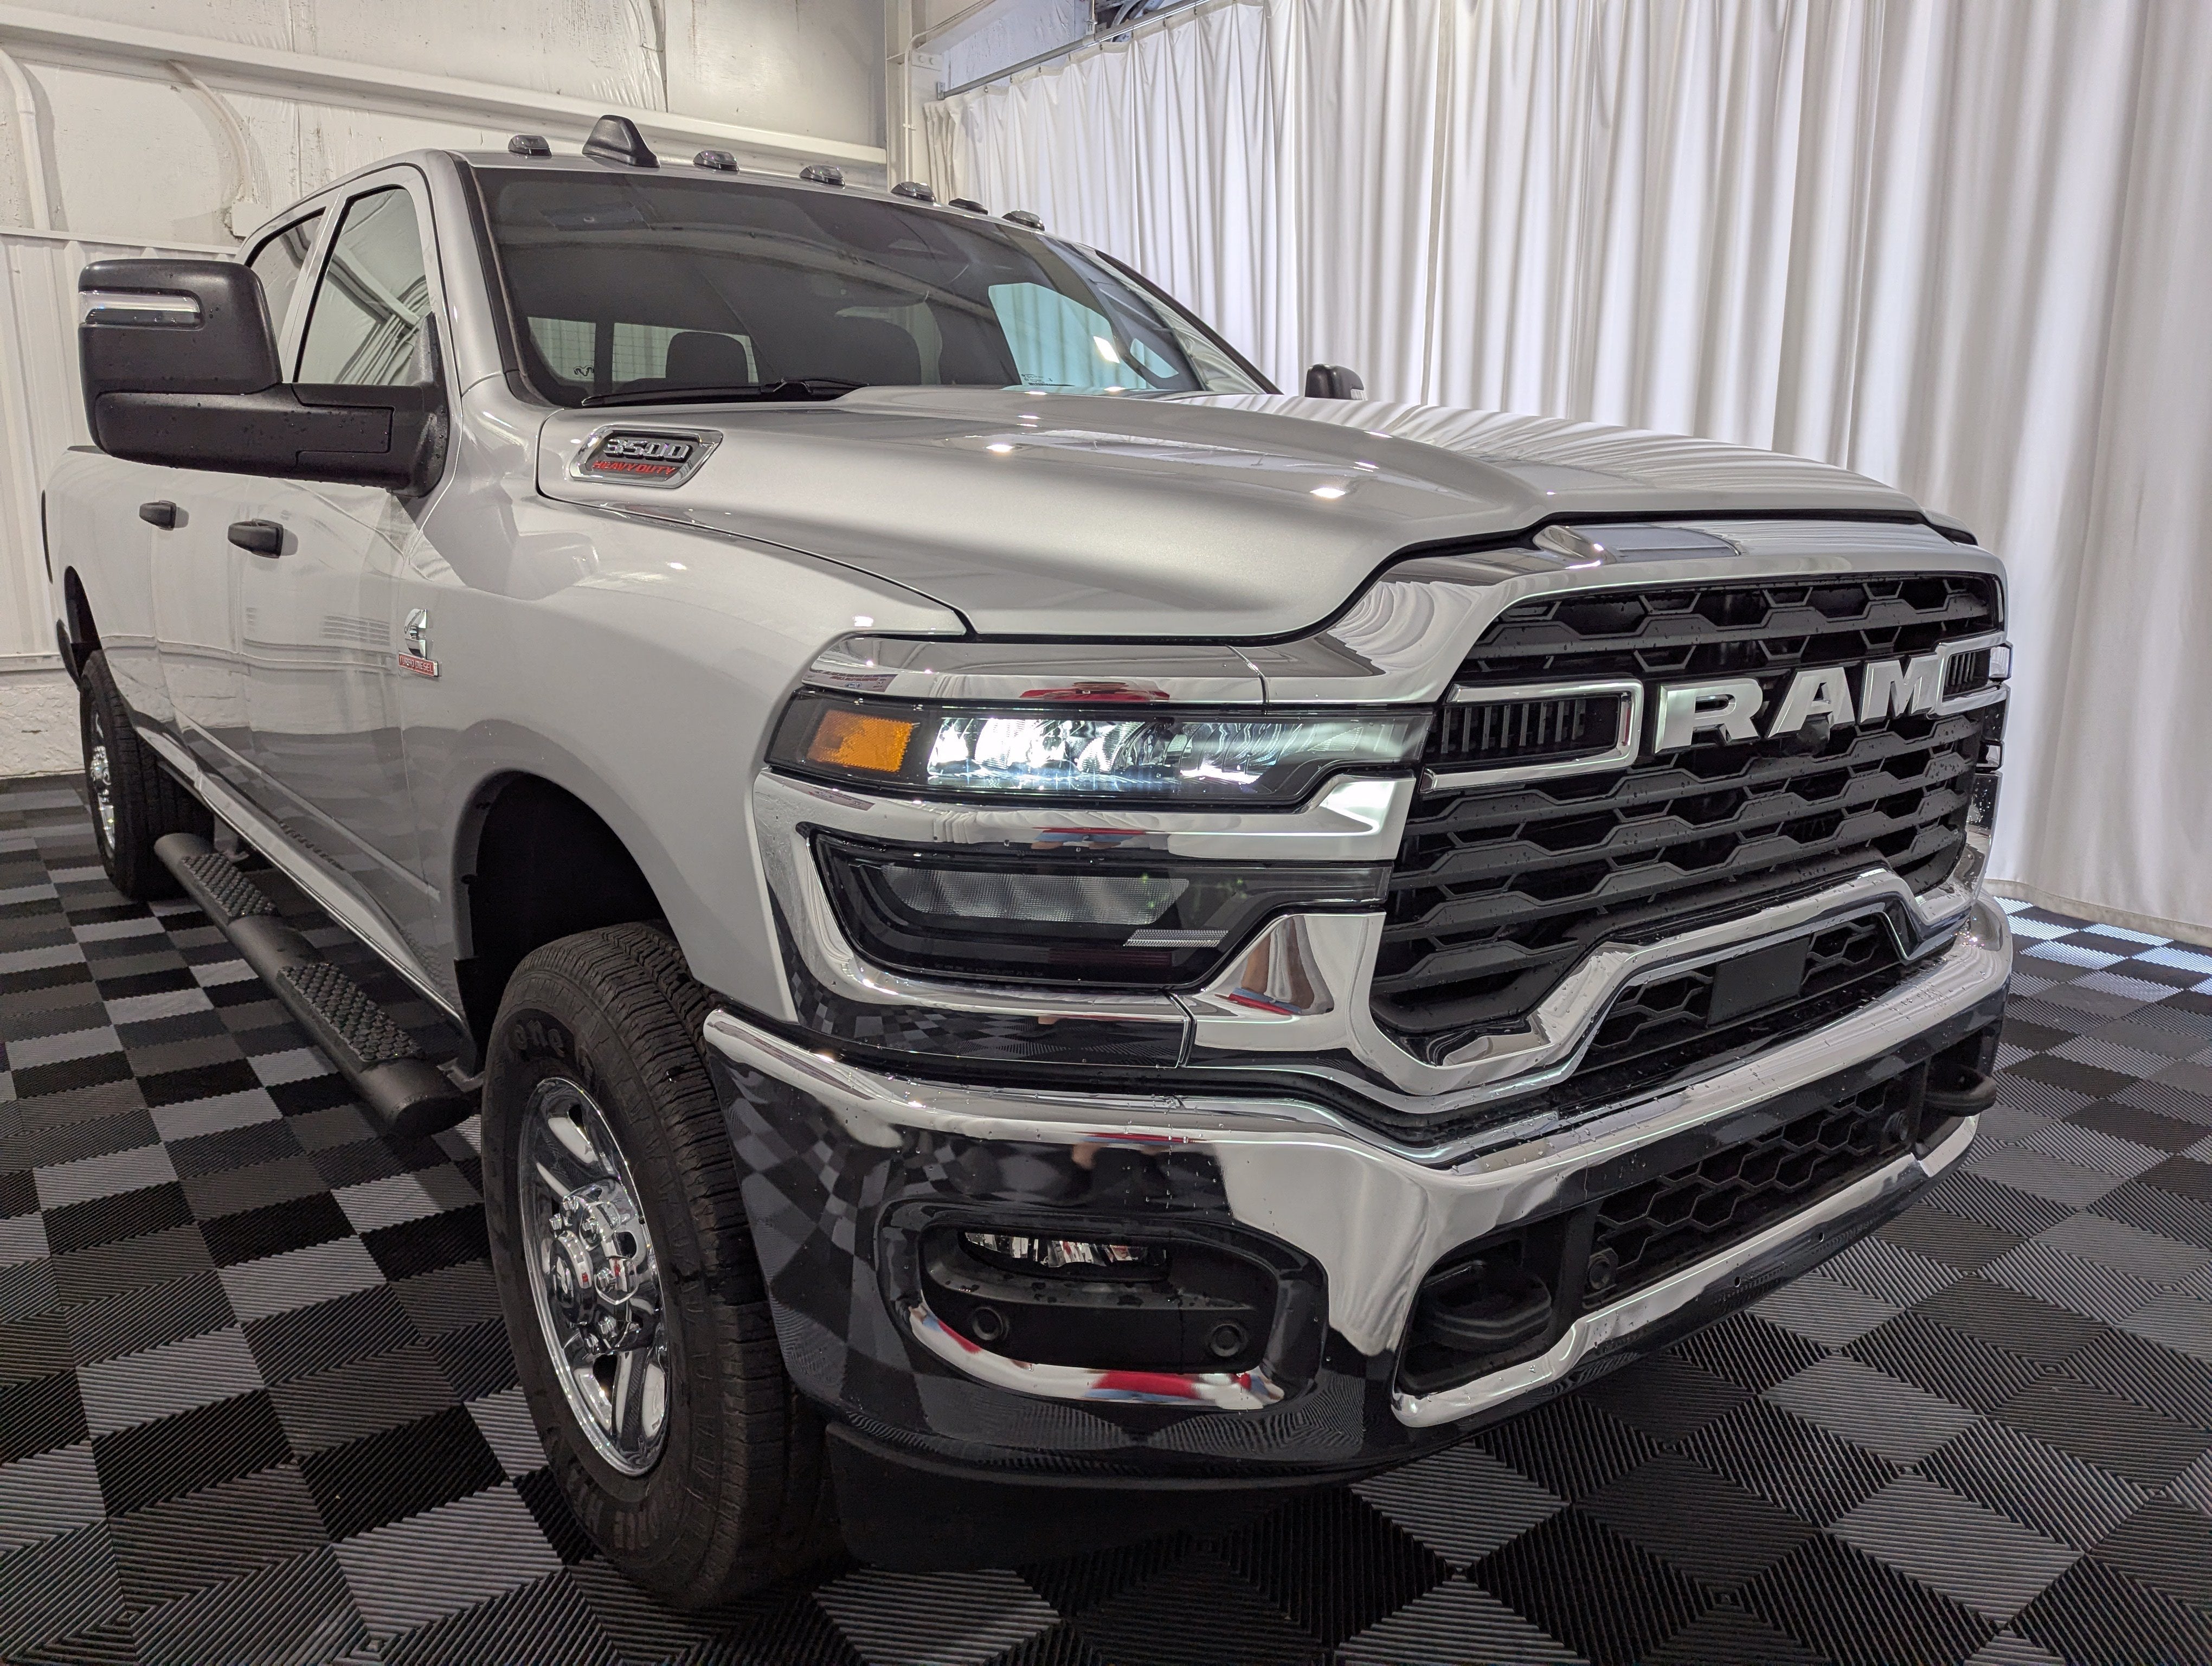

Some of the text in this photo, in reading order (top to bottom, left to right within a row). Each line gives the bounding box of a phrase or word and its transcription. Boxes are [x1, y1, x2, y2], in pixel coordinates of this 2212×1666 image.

[603, 438, 692, 460] 3500
[592, 460, 677, 475] HEAVY DUTY
[415, 659, 434, 673] DIESEL
[1654, 651, 1941, 754] RAM
